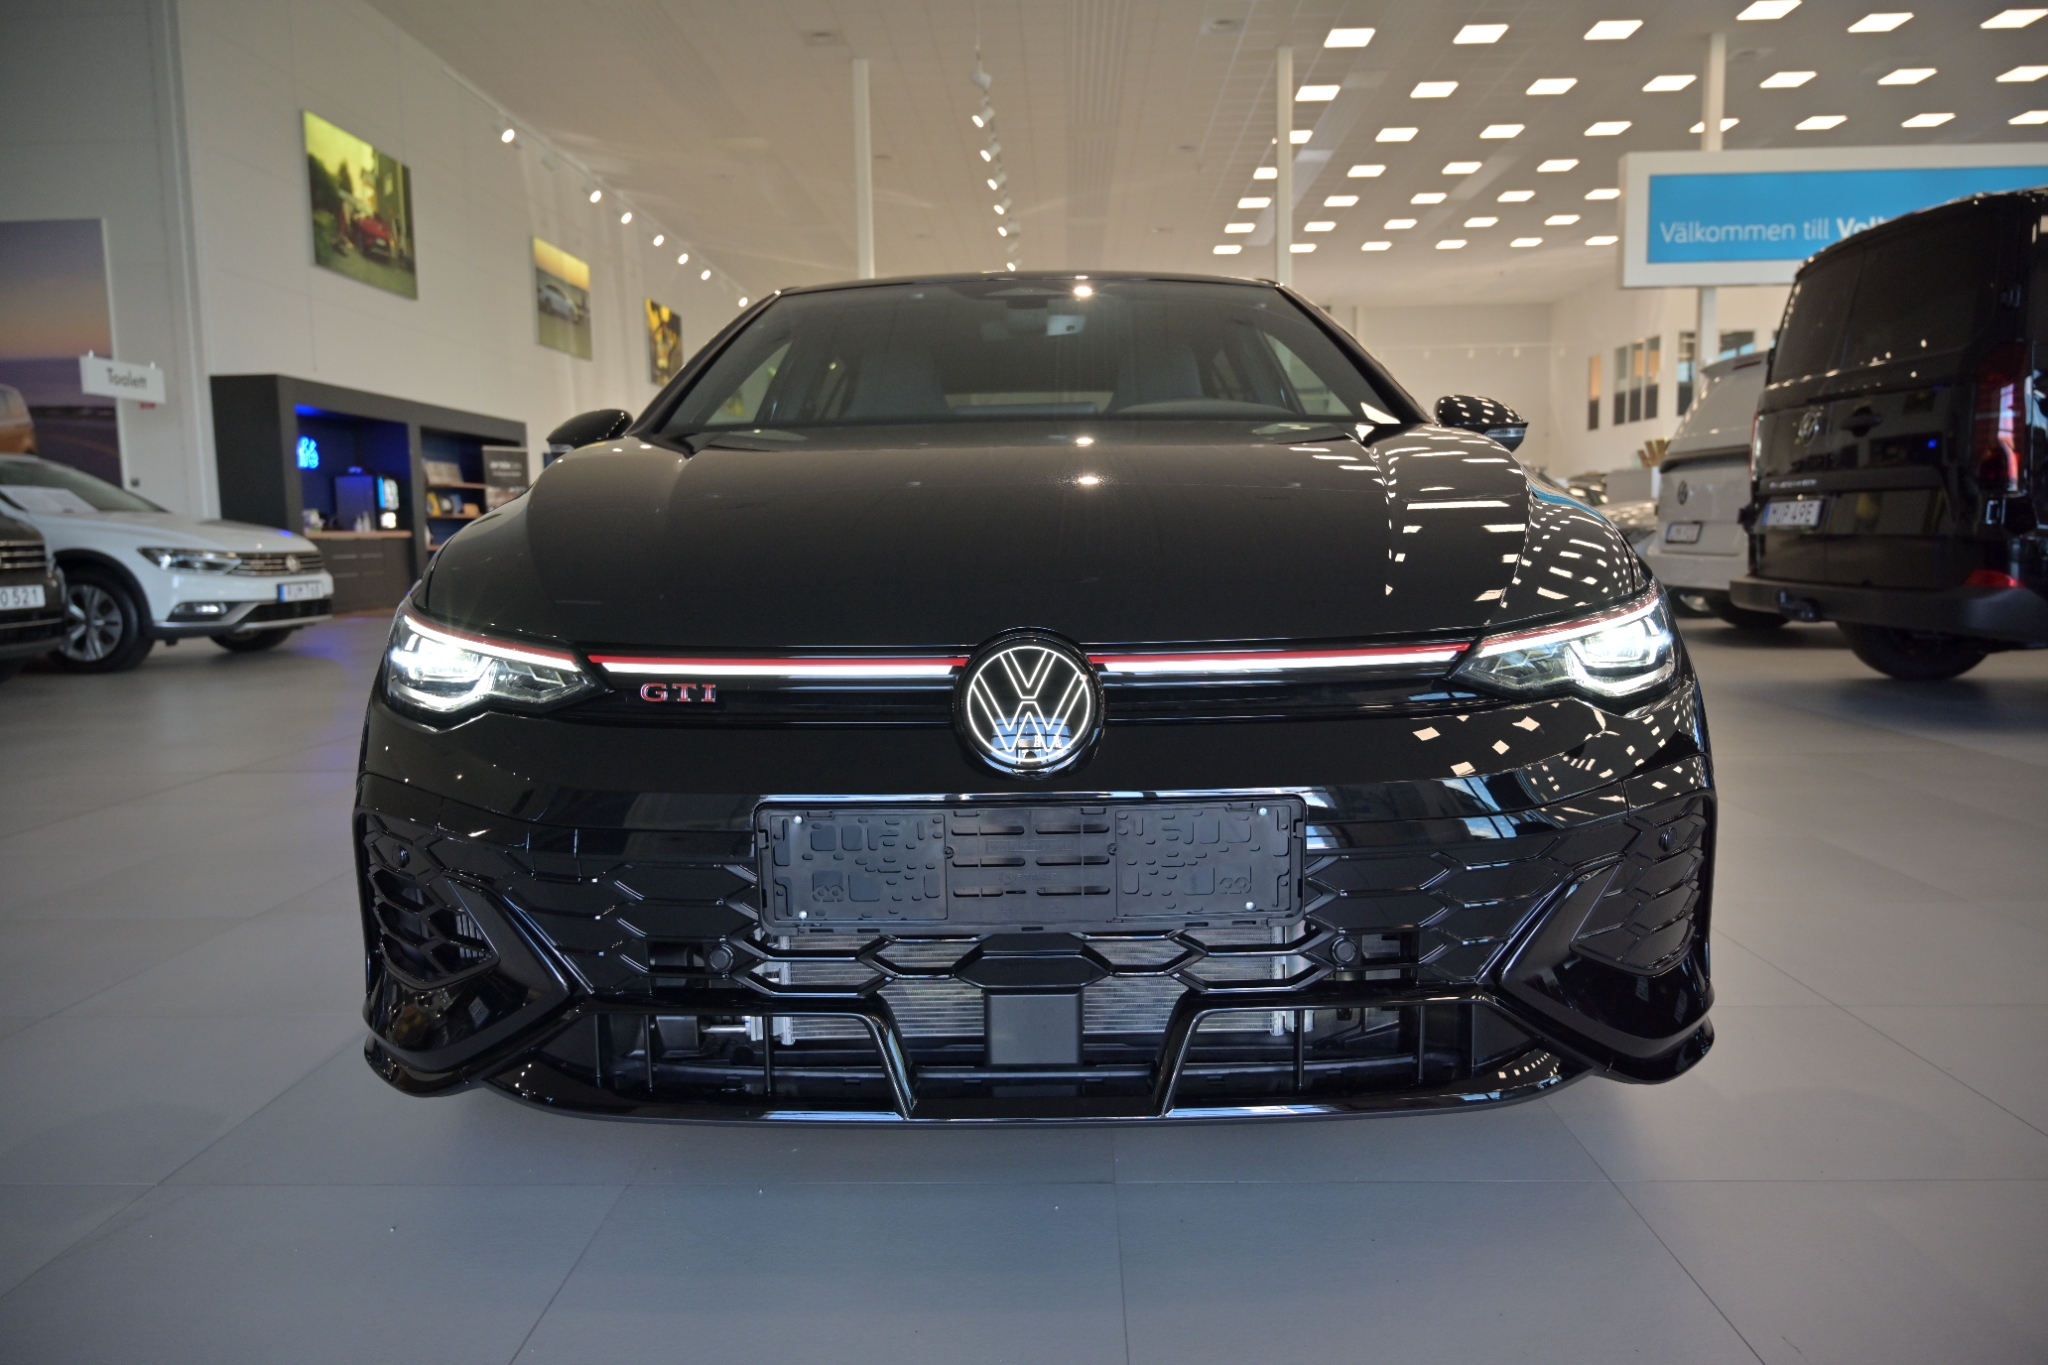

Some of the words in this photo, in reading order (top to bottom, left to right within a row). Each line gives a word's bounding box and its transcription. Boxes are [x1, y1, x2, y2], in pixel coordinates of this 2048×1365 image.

[1659, 220, 1796, 244] Välkommen
[1803, 217, 1830, 241] till
[640, 682, 717, 703] GTI
